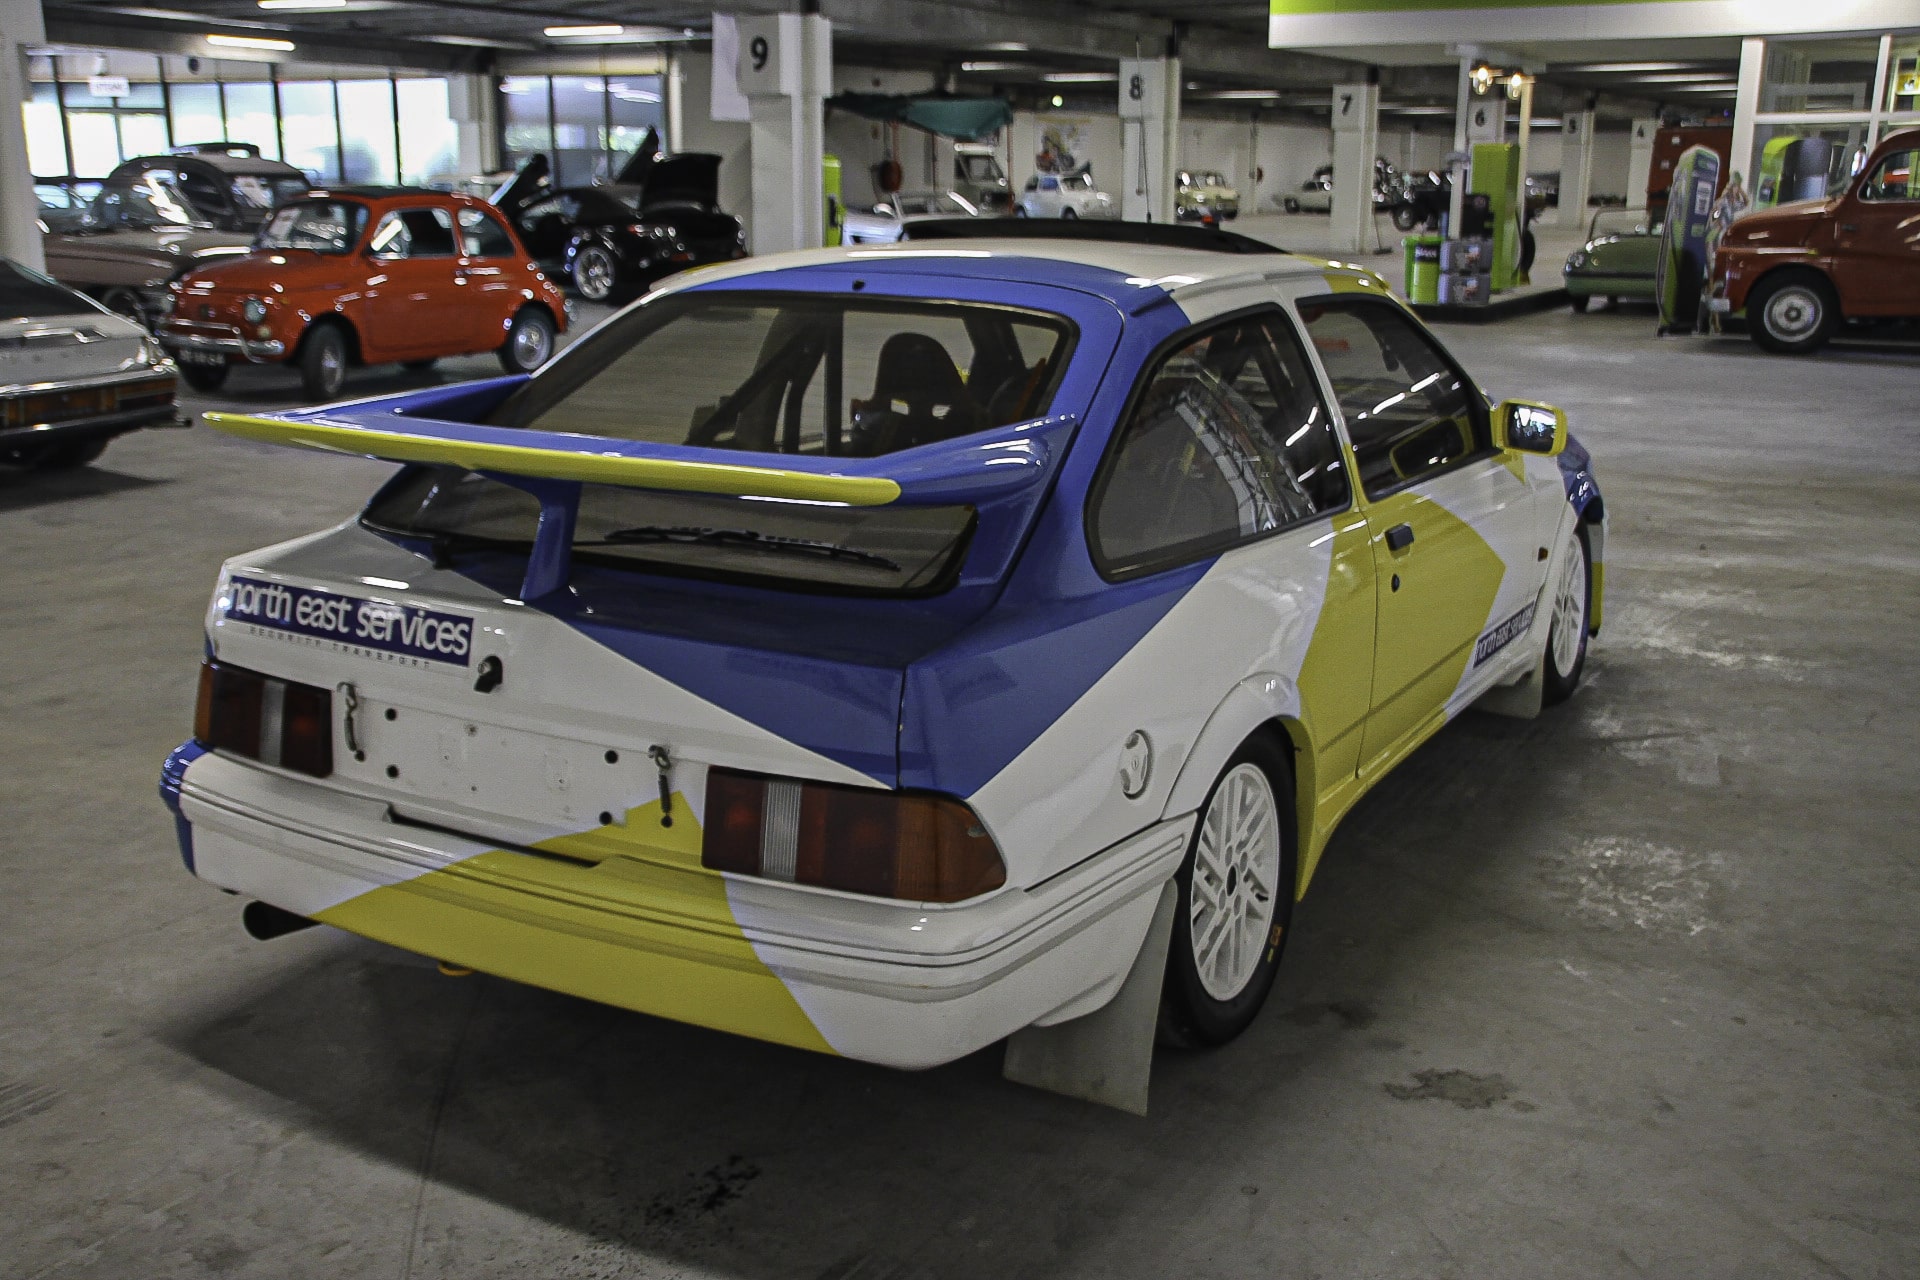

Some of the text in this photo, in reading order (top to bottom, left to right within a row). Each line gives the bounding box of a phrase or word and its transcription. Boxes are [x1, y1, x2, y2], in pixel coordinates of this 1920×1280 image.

[750, 35, 769, 72] 9
[1129, 73, 1144, 100] 8
[1340, 92, 1352, 116] 7
[1475, 107, 1486, 127] 6
[229, 581, 471, 657] north east services
[249, 625, 431, 669] SECURITY TRANSPORT
